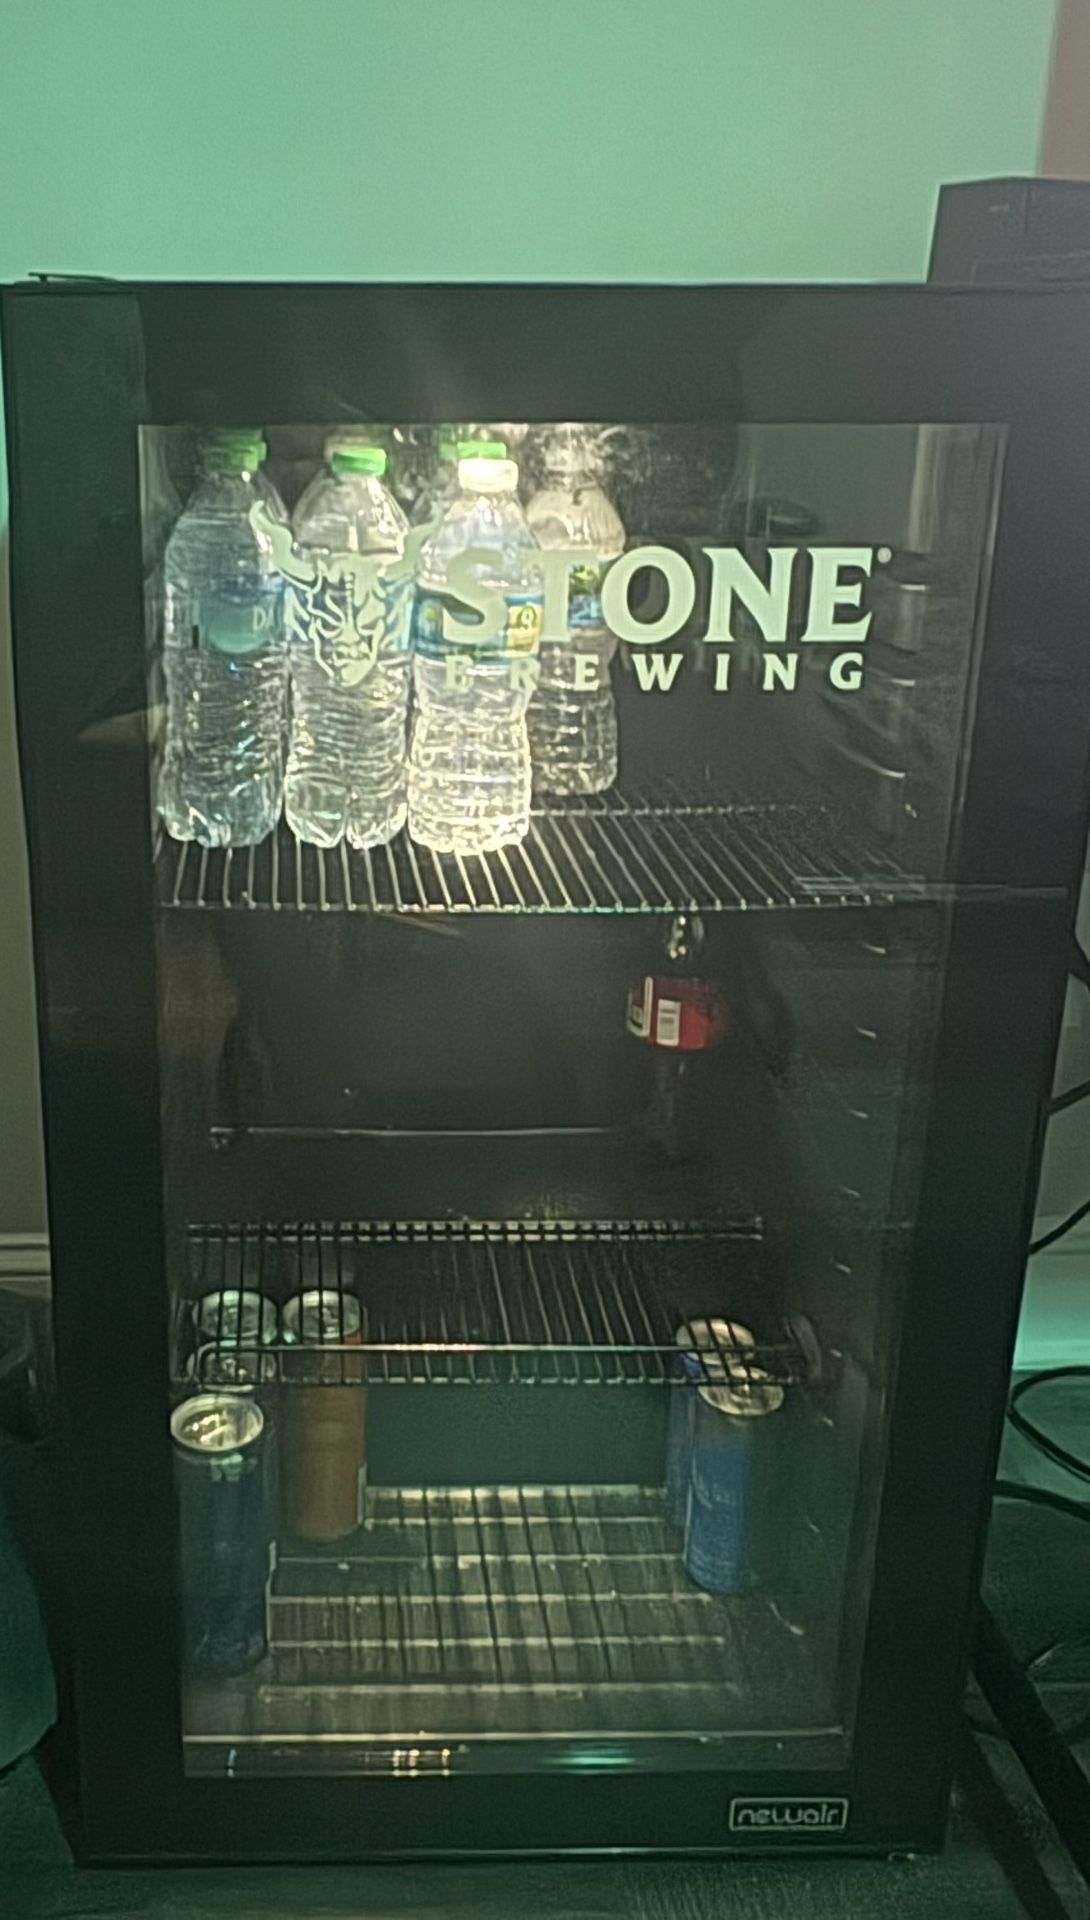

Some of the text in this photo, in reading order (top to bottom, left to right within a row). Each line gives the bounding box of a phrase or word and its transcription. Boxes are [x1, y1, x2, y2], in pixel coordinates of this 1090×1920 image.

[443, 546, 873, 643] STONE
[445, 652, 864, 692] BREWING
[737, 1803, 839, 1824] newair
